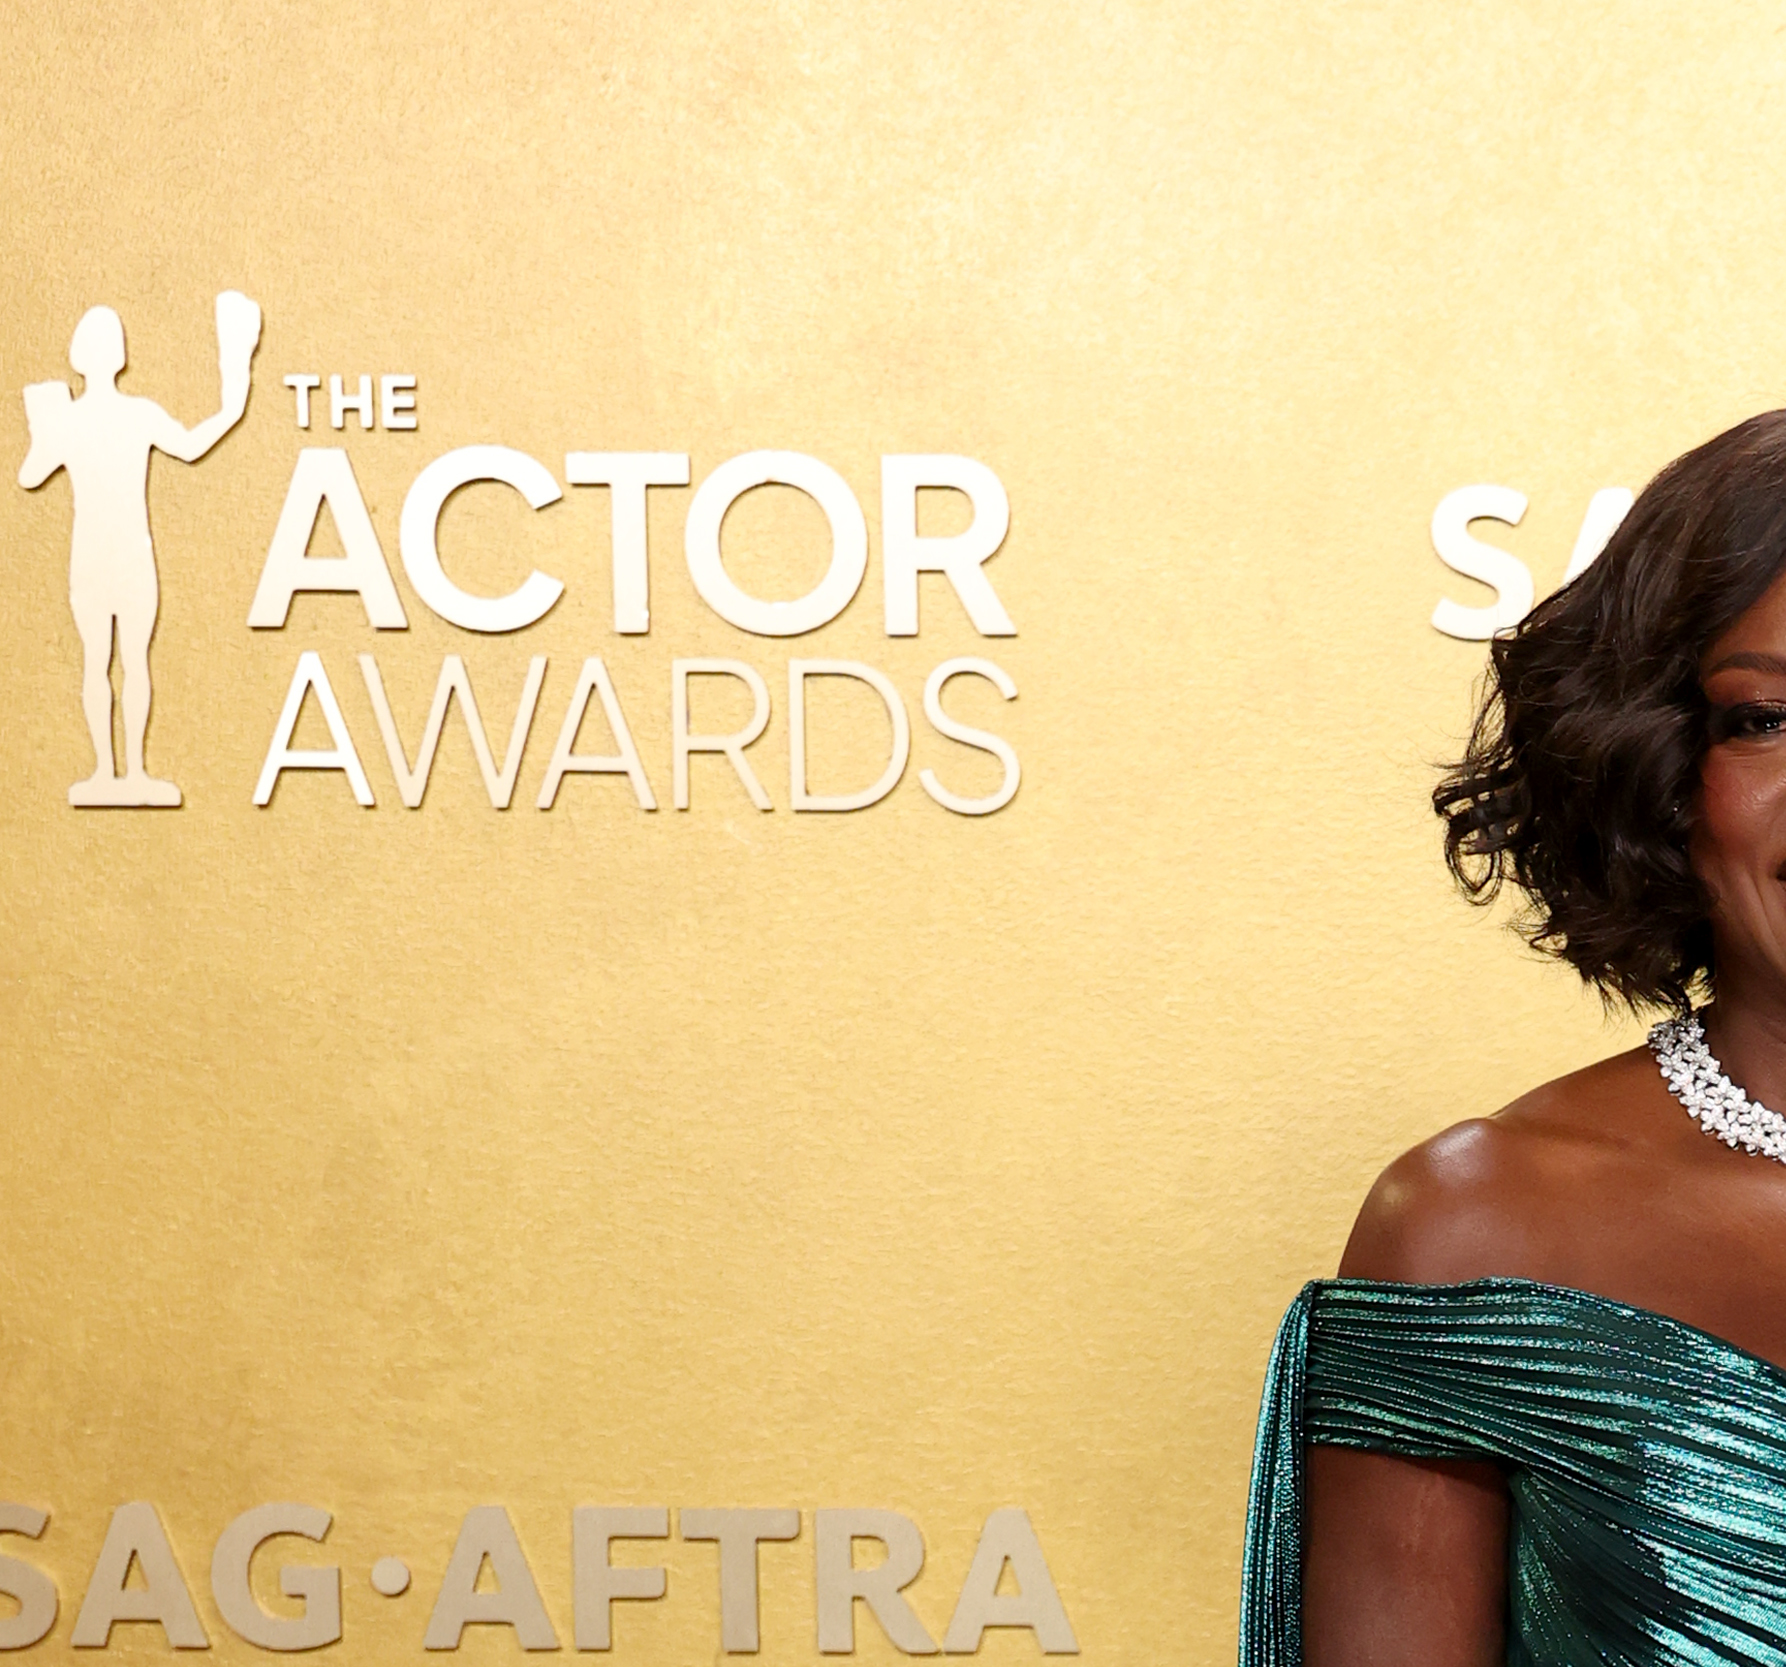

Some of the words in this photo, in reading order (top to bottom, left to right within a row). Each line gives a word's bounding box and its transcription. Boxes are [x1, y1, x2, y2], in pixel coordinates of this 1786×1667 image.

[284, 374, 417, 430] THE
[247, 444, 1018, 637] ACTOR
[252, 650, 1021, 817] AWARDS
